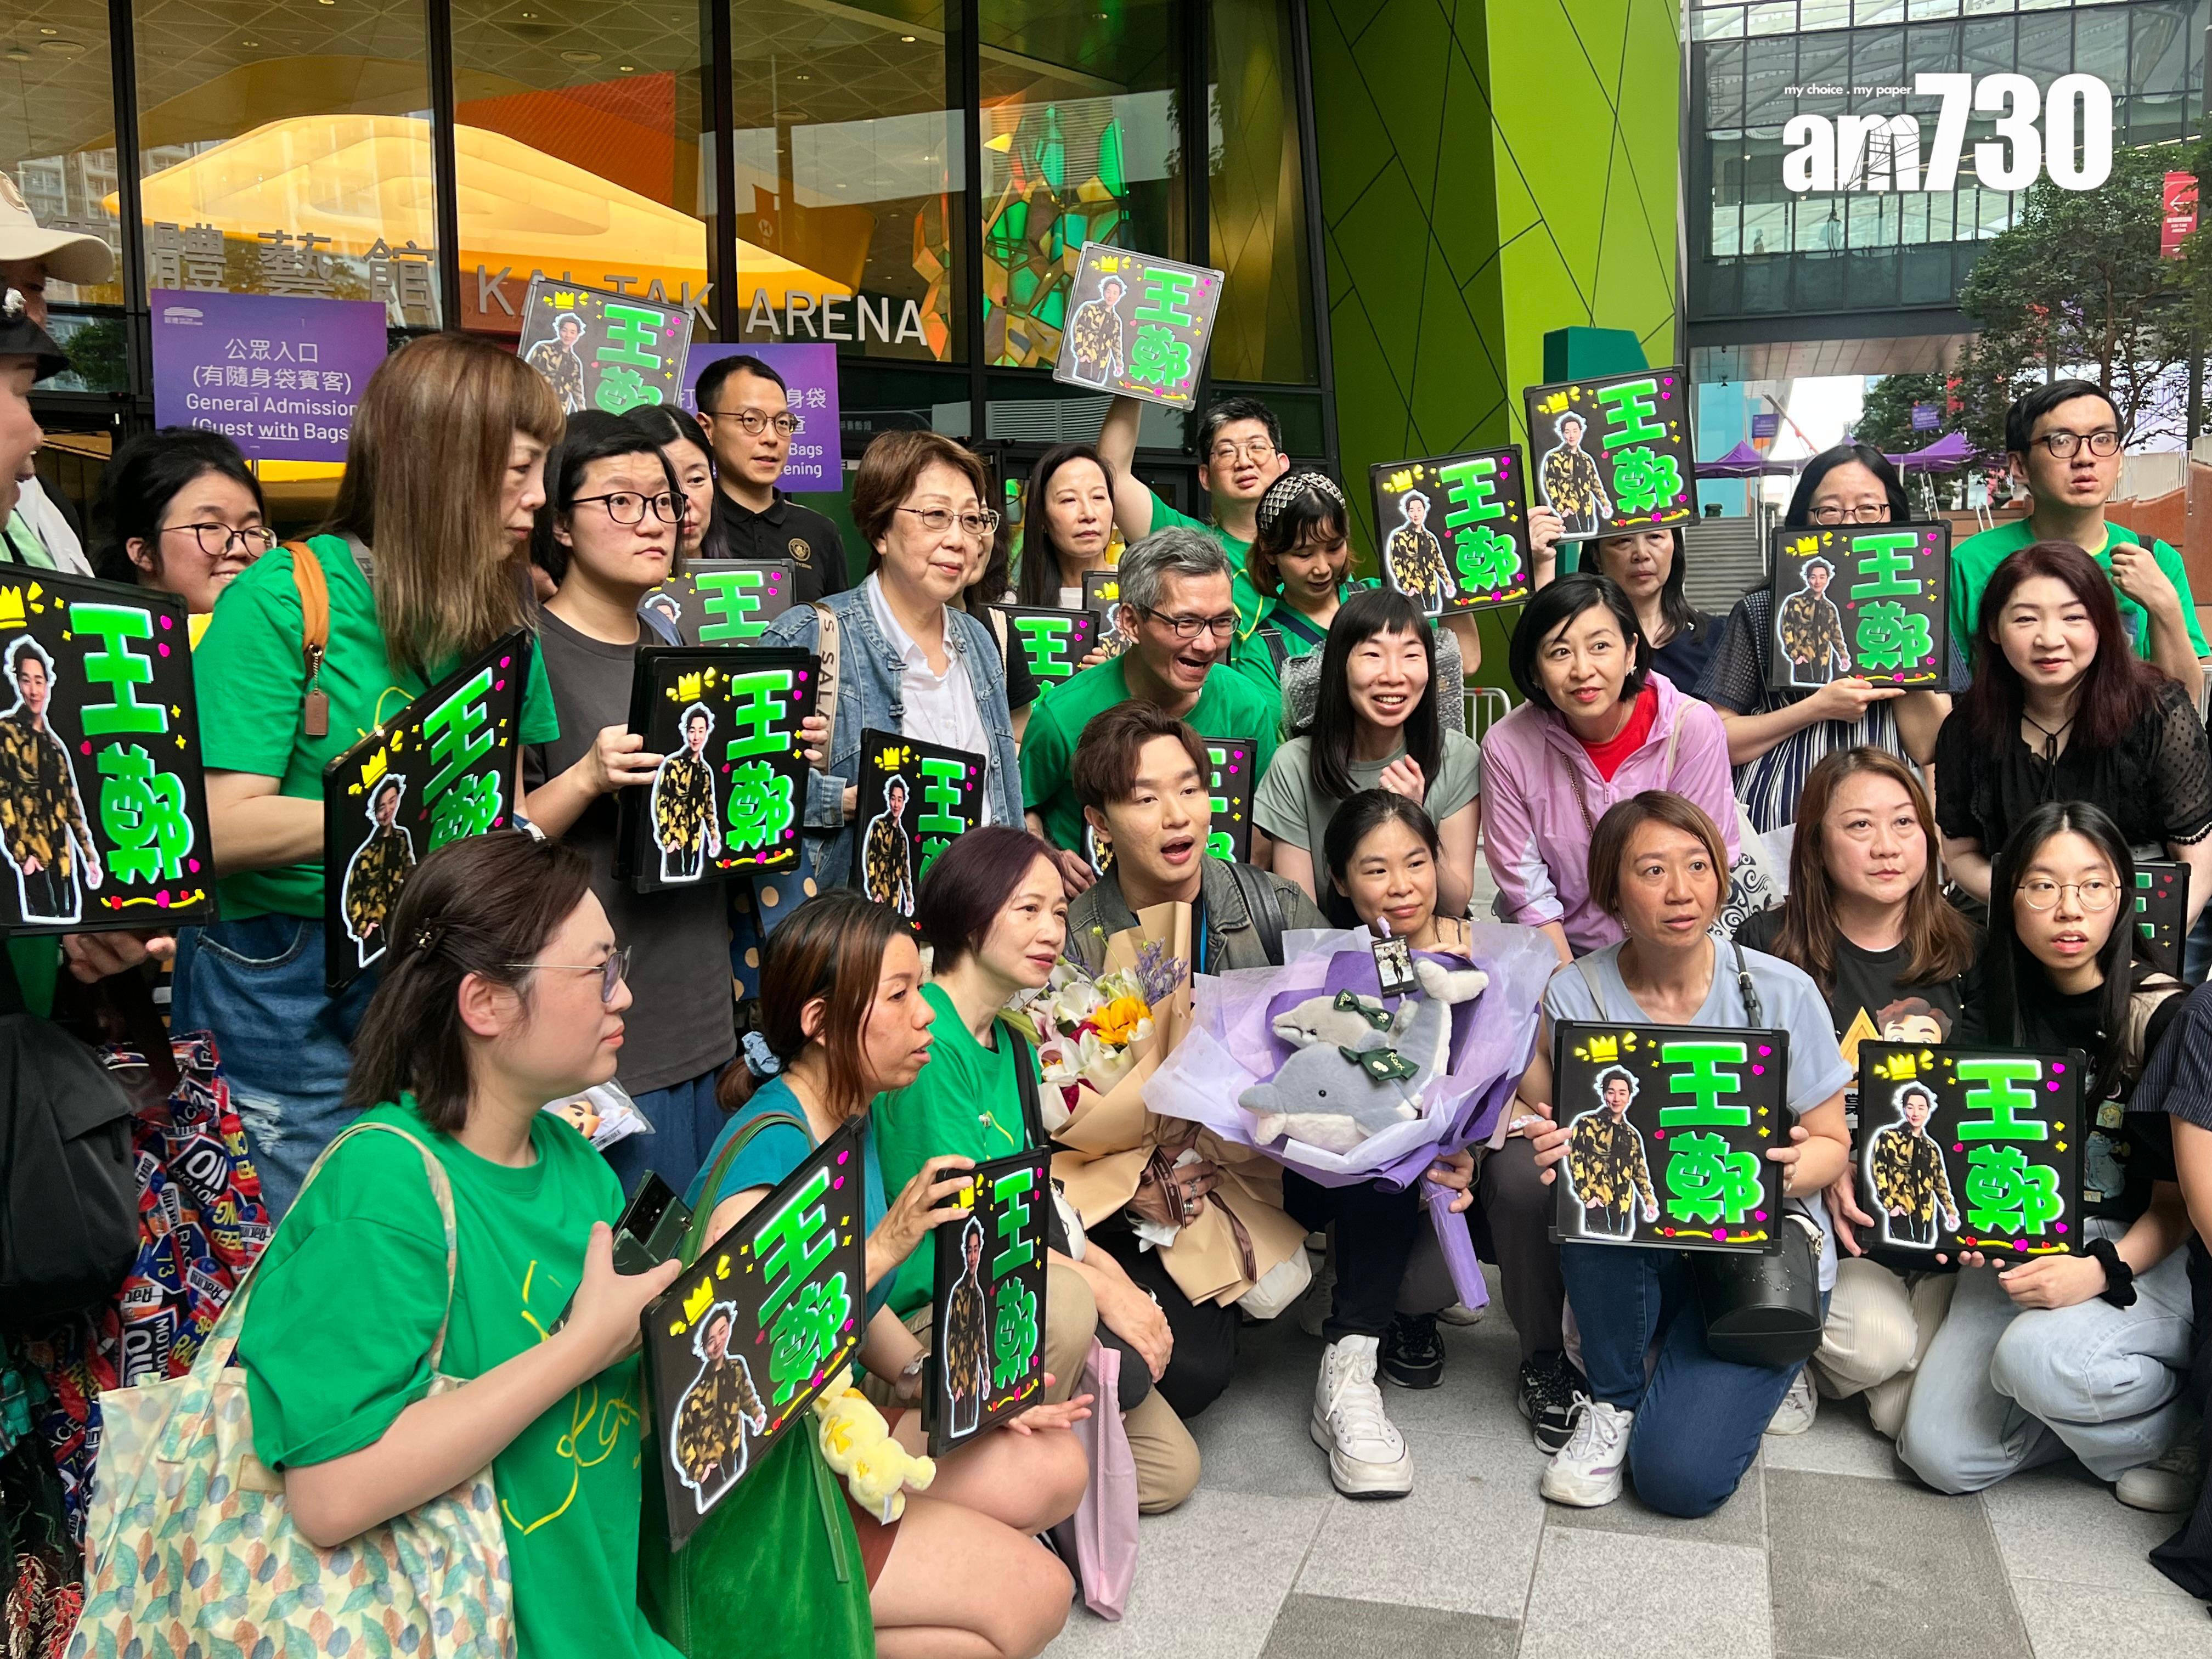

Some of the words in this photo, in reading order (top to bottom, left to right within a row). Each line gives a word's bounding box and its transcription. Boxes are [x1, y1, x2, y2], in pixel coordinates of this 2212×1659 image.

[745, 288, 928, 346] ARENA
[224, 338, 318, 363] 公眾入口
[193, 364, 352, 396] (有隨身袋賓客)
[187, 393, 259, 413] General
[258, 421, 299, 438] with
[789, 442, 823, 459] Bags
